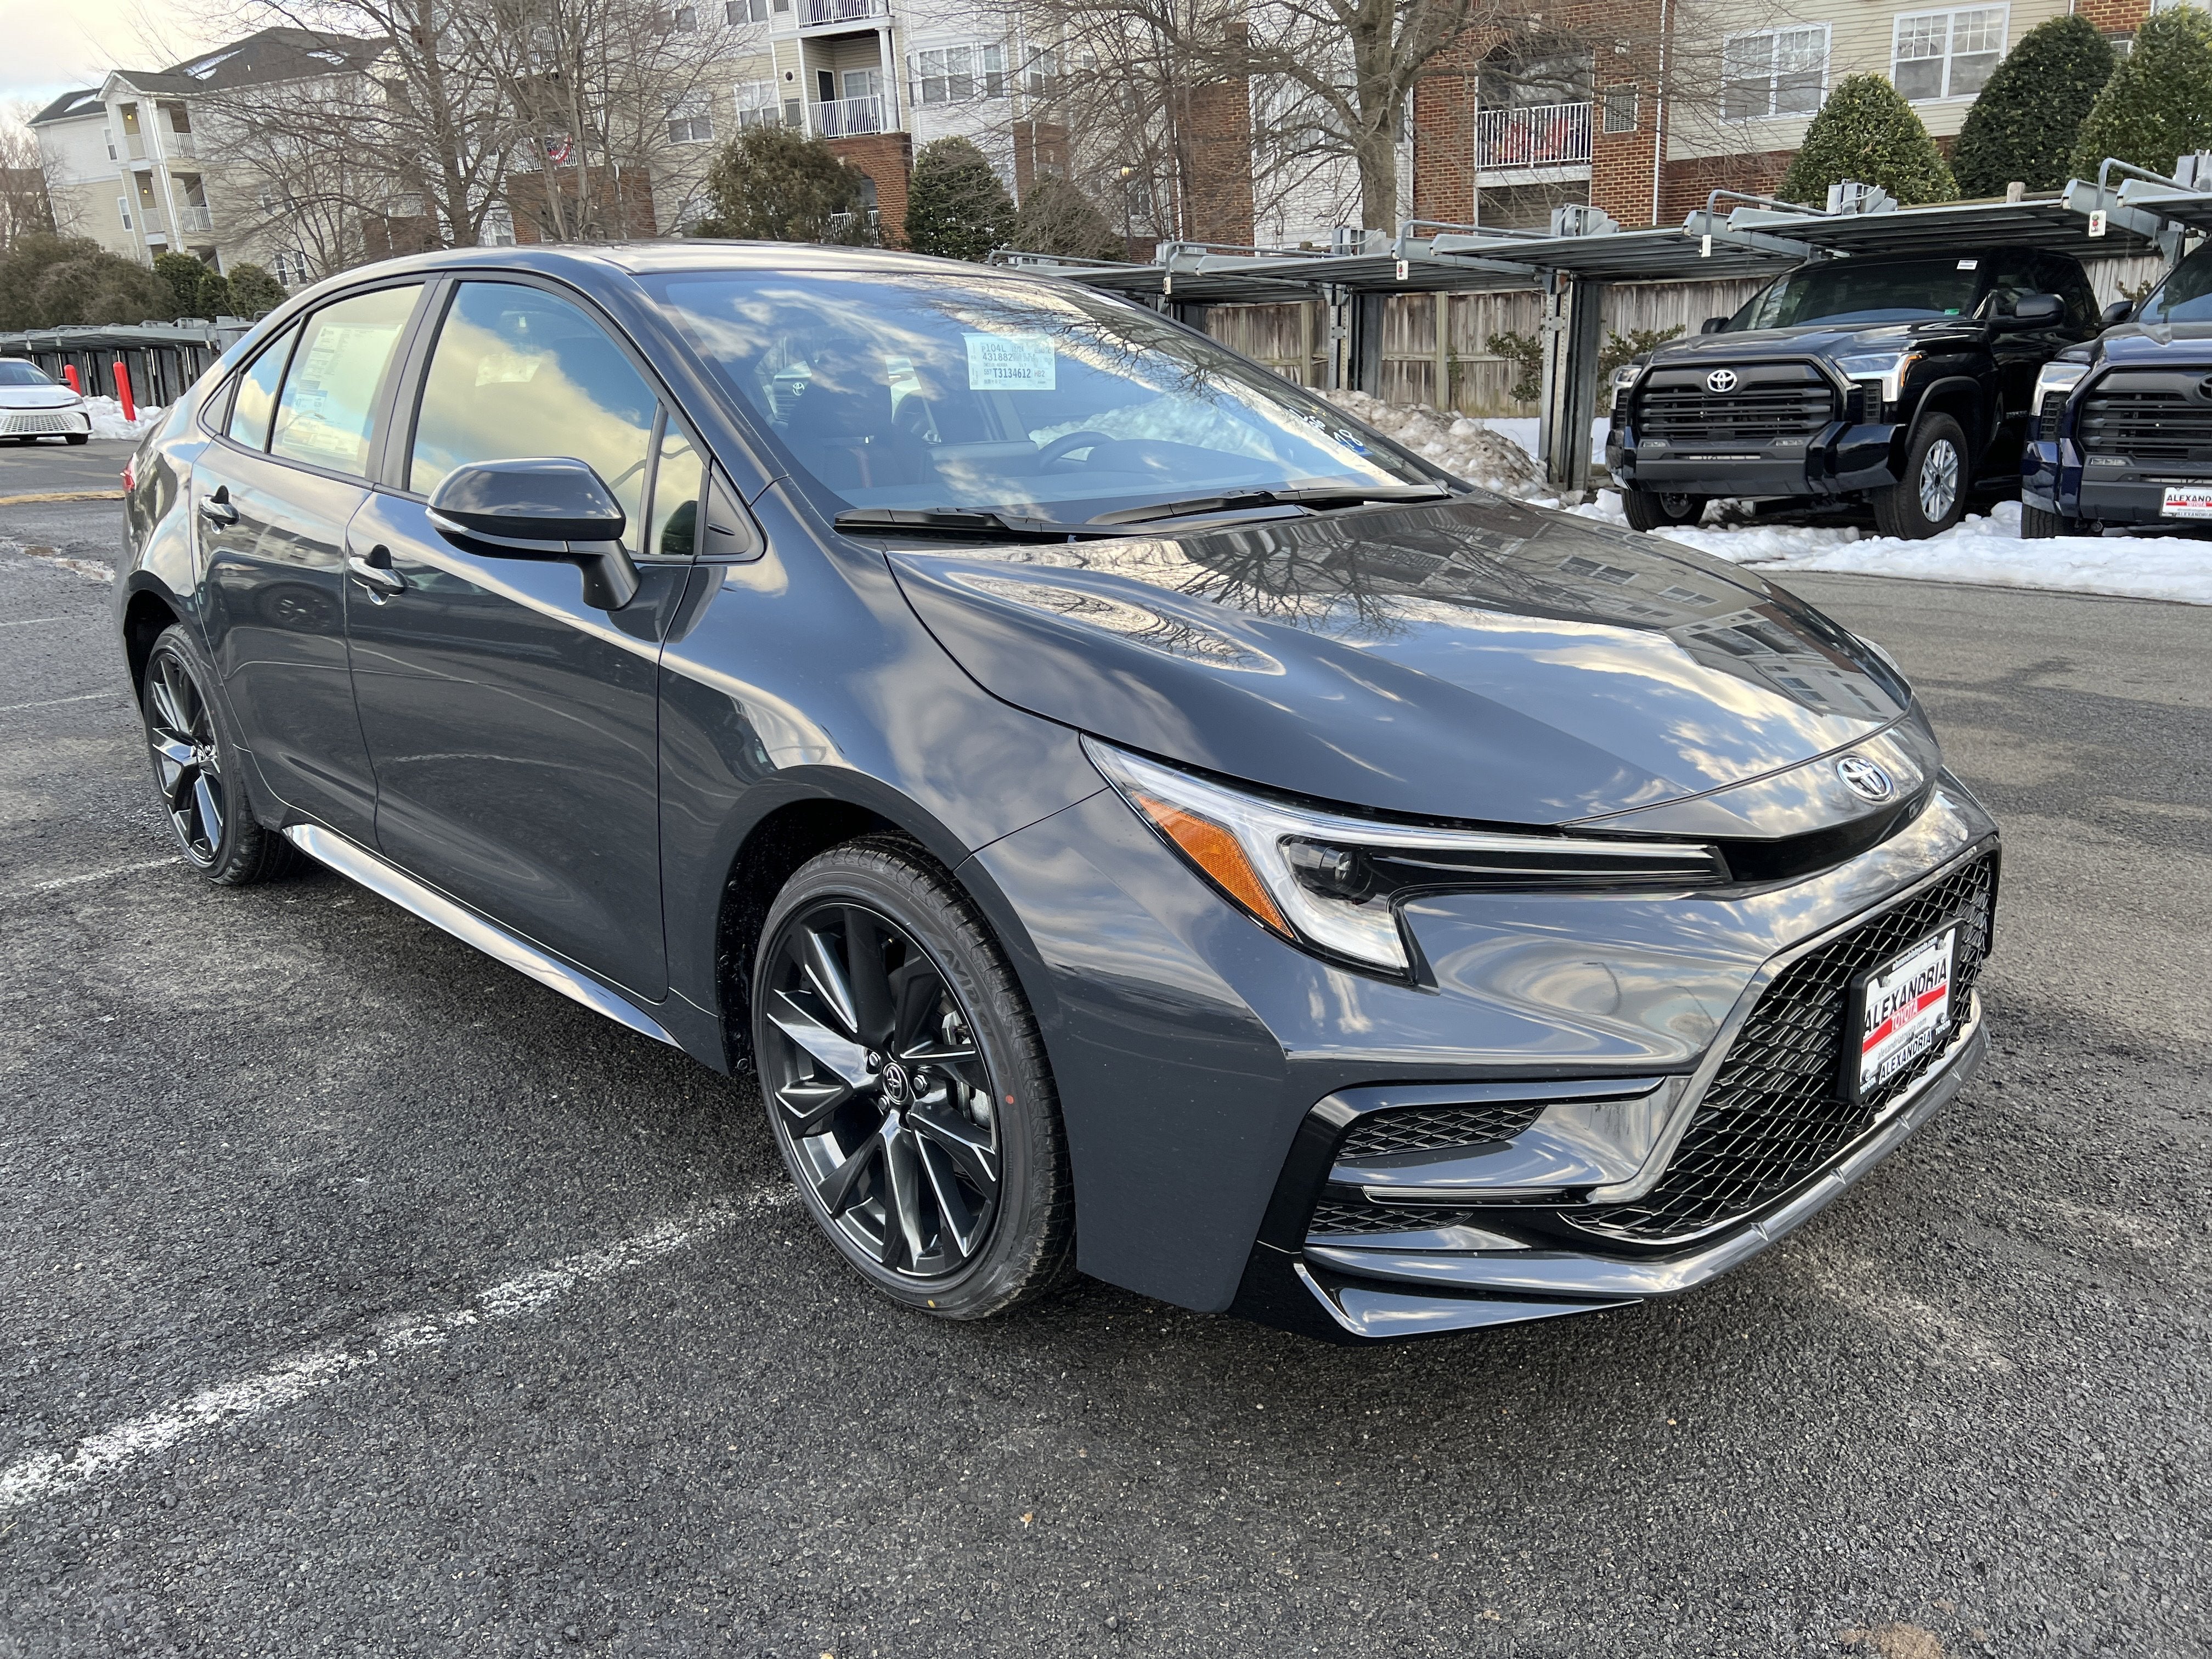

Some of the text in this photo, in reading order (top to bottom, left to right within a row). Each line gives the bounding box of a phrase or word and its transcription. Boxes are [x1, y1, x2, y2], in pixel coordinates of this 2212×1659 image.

[983, 353, 1013, 361] 431882
[992, 368, 1031, 379] T3134612
[938, 949, 998, 1041] AVID GT
[1865, 957, 1946, 1032] ALEXANDRIA
[1892, 999, 1918, 1031] TOYOTA
[1935, 1019, 1951, 1036] TOYOTA
[1877, 1017, 1927, 1060] alexandriatoyota.com
[1880, 1030, 1931, 1083] ALEXANDRIA
[1860, 1076, 1876, 1095] TOYOTA
